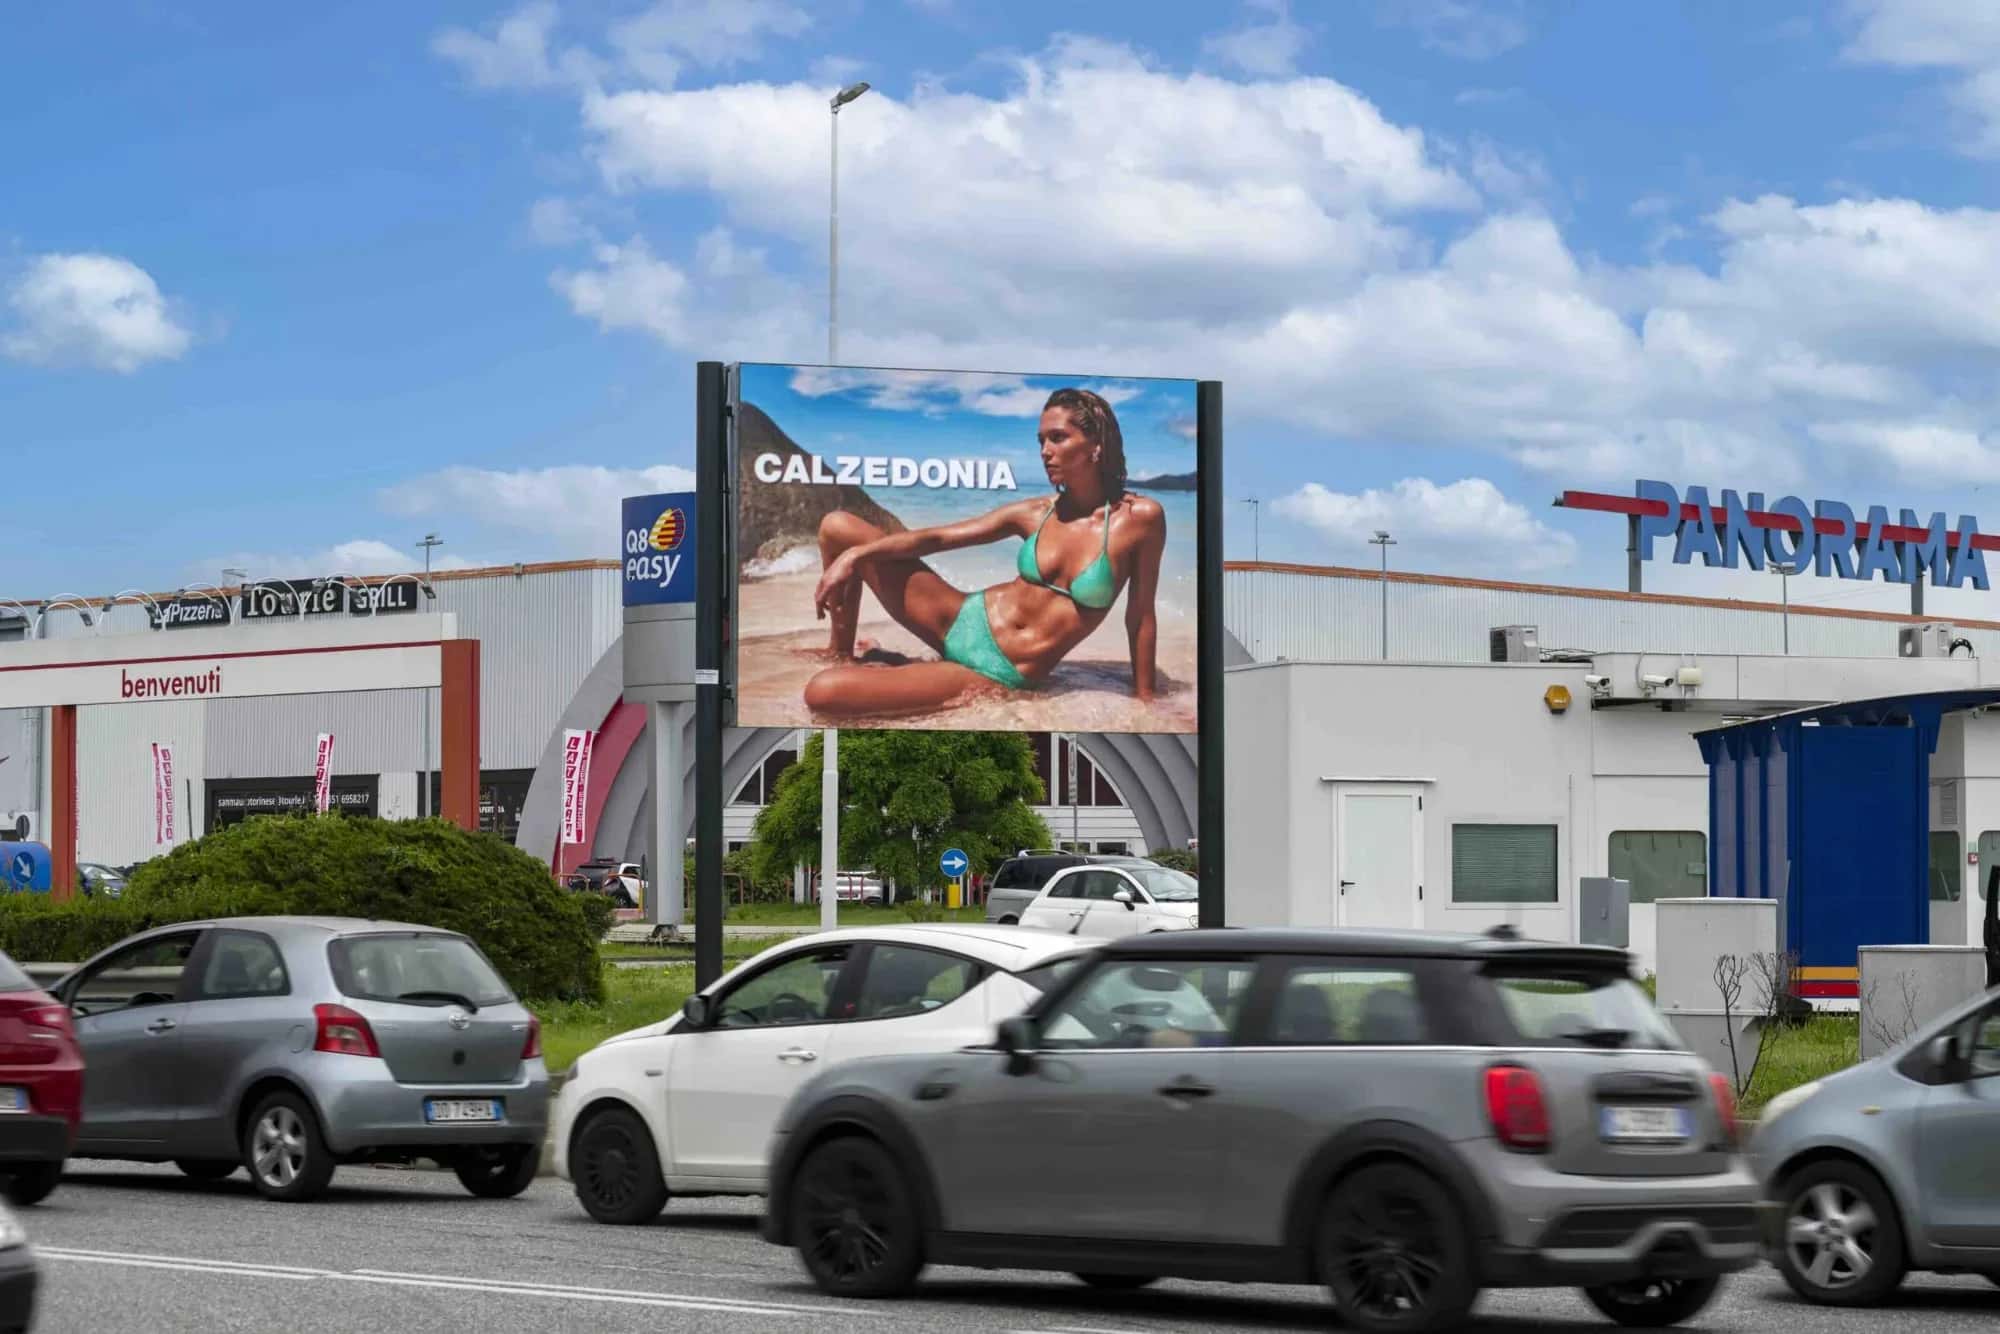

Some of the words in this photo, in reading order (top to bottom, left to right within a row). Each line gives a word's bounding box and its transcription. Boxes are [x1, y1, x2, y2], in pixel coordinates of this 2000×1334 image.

[754, 453, 1017, 490] CALZEDONIA
[626, 529, 648, 553] Q8
[1636, 479, 1990, 590] PANORAMA
[626, 554, 681, 588] easy
[356, 585, 407, 609] GRILL
[122, 666, 220, 698] benvenuti
